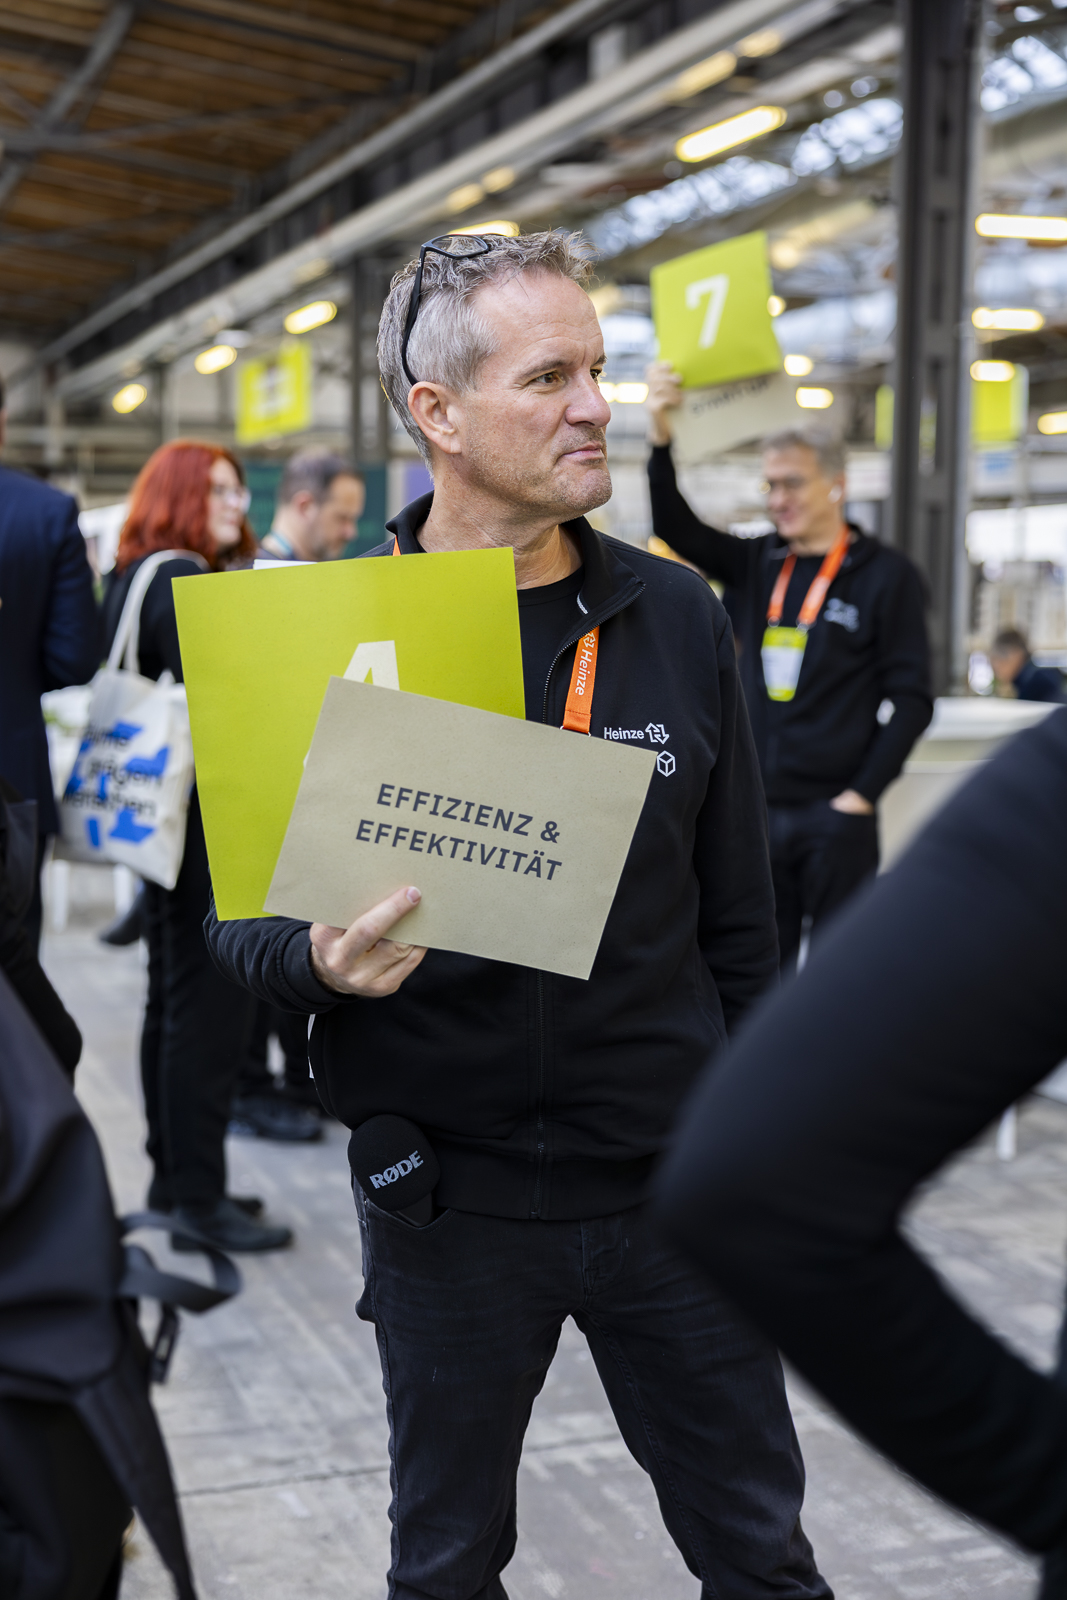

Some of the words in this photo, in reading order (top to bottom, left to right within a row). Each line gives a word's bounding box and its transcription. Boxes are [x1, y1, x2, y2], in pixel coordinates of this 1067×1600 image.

[685, 273, 729, 349] 7
[575, 648, 593, 696] Heinze
[603, 726, 645, 740] Heinze
[376, 783, 534, 837] EFFIZIENZ
[540, 820, 561, 844] &
[355, 819, 563, 881] EFFEKTIVITÄT
[369, 1150, 424, 1190] RØDE
